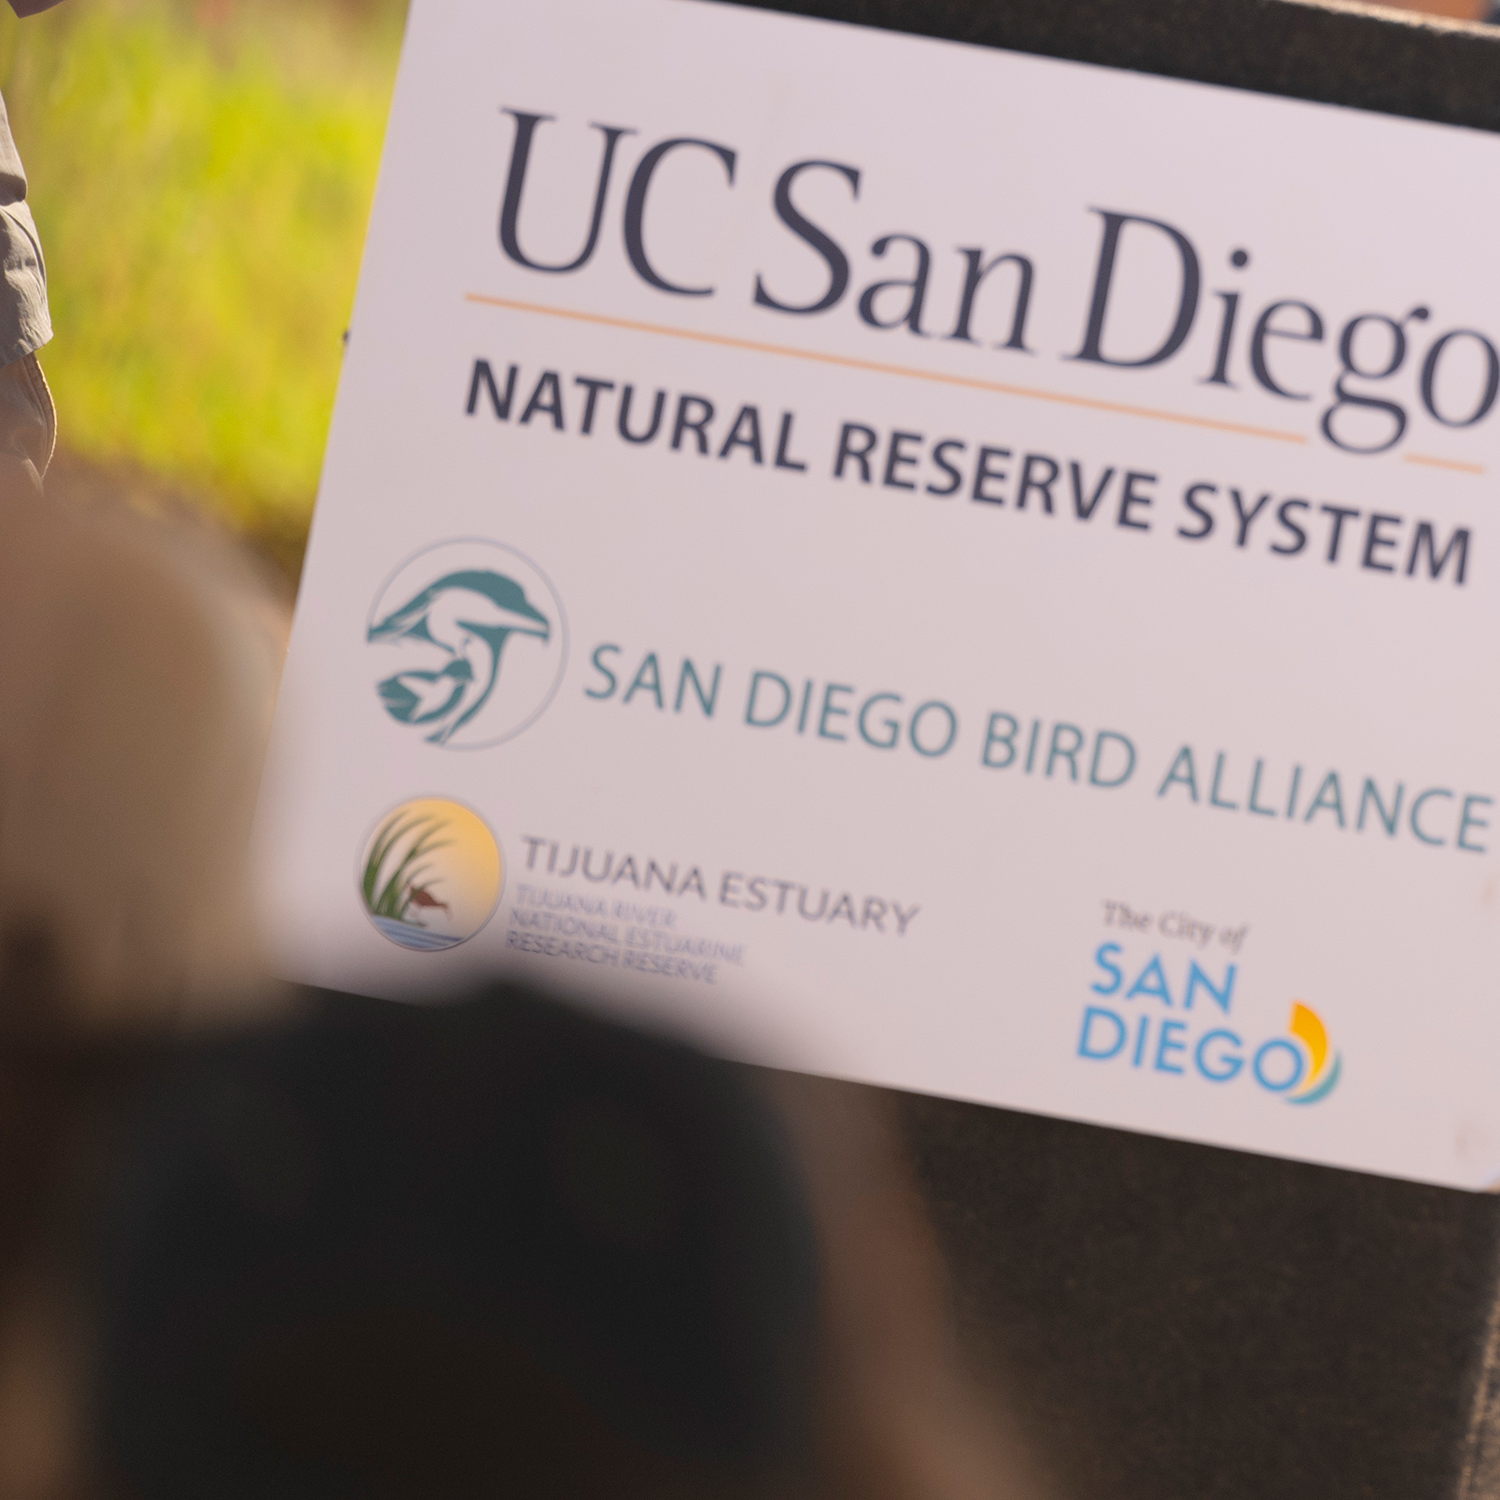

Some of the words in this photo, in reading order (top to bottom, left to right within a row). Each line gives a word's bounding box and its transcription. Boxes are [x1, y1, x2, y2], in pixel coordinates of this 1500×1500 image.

[498, 108, 738, 298] UC
[752, 159, 1035, 352] San
[465, 358, 807, 473] NATURAL
[832, 421, 1158, 532] RESERVE
[1176, 481, 1472, 586] SYSTEM
[585, 643, 722, 718] SAN
[744, 670, 958, 758] DIEGO
[980, 711, 1137, 788] BIRD
[1157, 744, 1493, 854] ALLIANCE
[510, 909, 616, 942] NATIONAL
[523, 835, 707, 900] TIJUANA
[718, 870, 920, 935] ESTUARY
[1104, 900, 1152, 932] The
[1158, 911, 1215, 948] City
[1219, 925, 1248, 954] of
[504, 930, 616, 962] RESEARCH
[624, 950, 715, 982] RESERVE
[1092, 942, 1236, 1012] SAN
[1075, 1005, 1303, 1093] DIEGO
